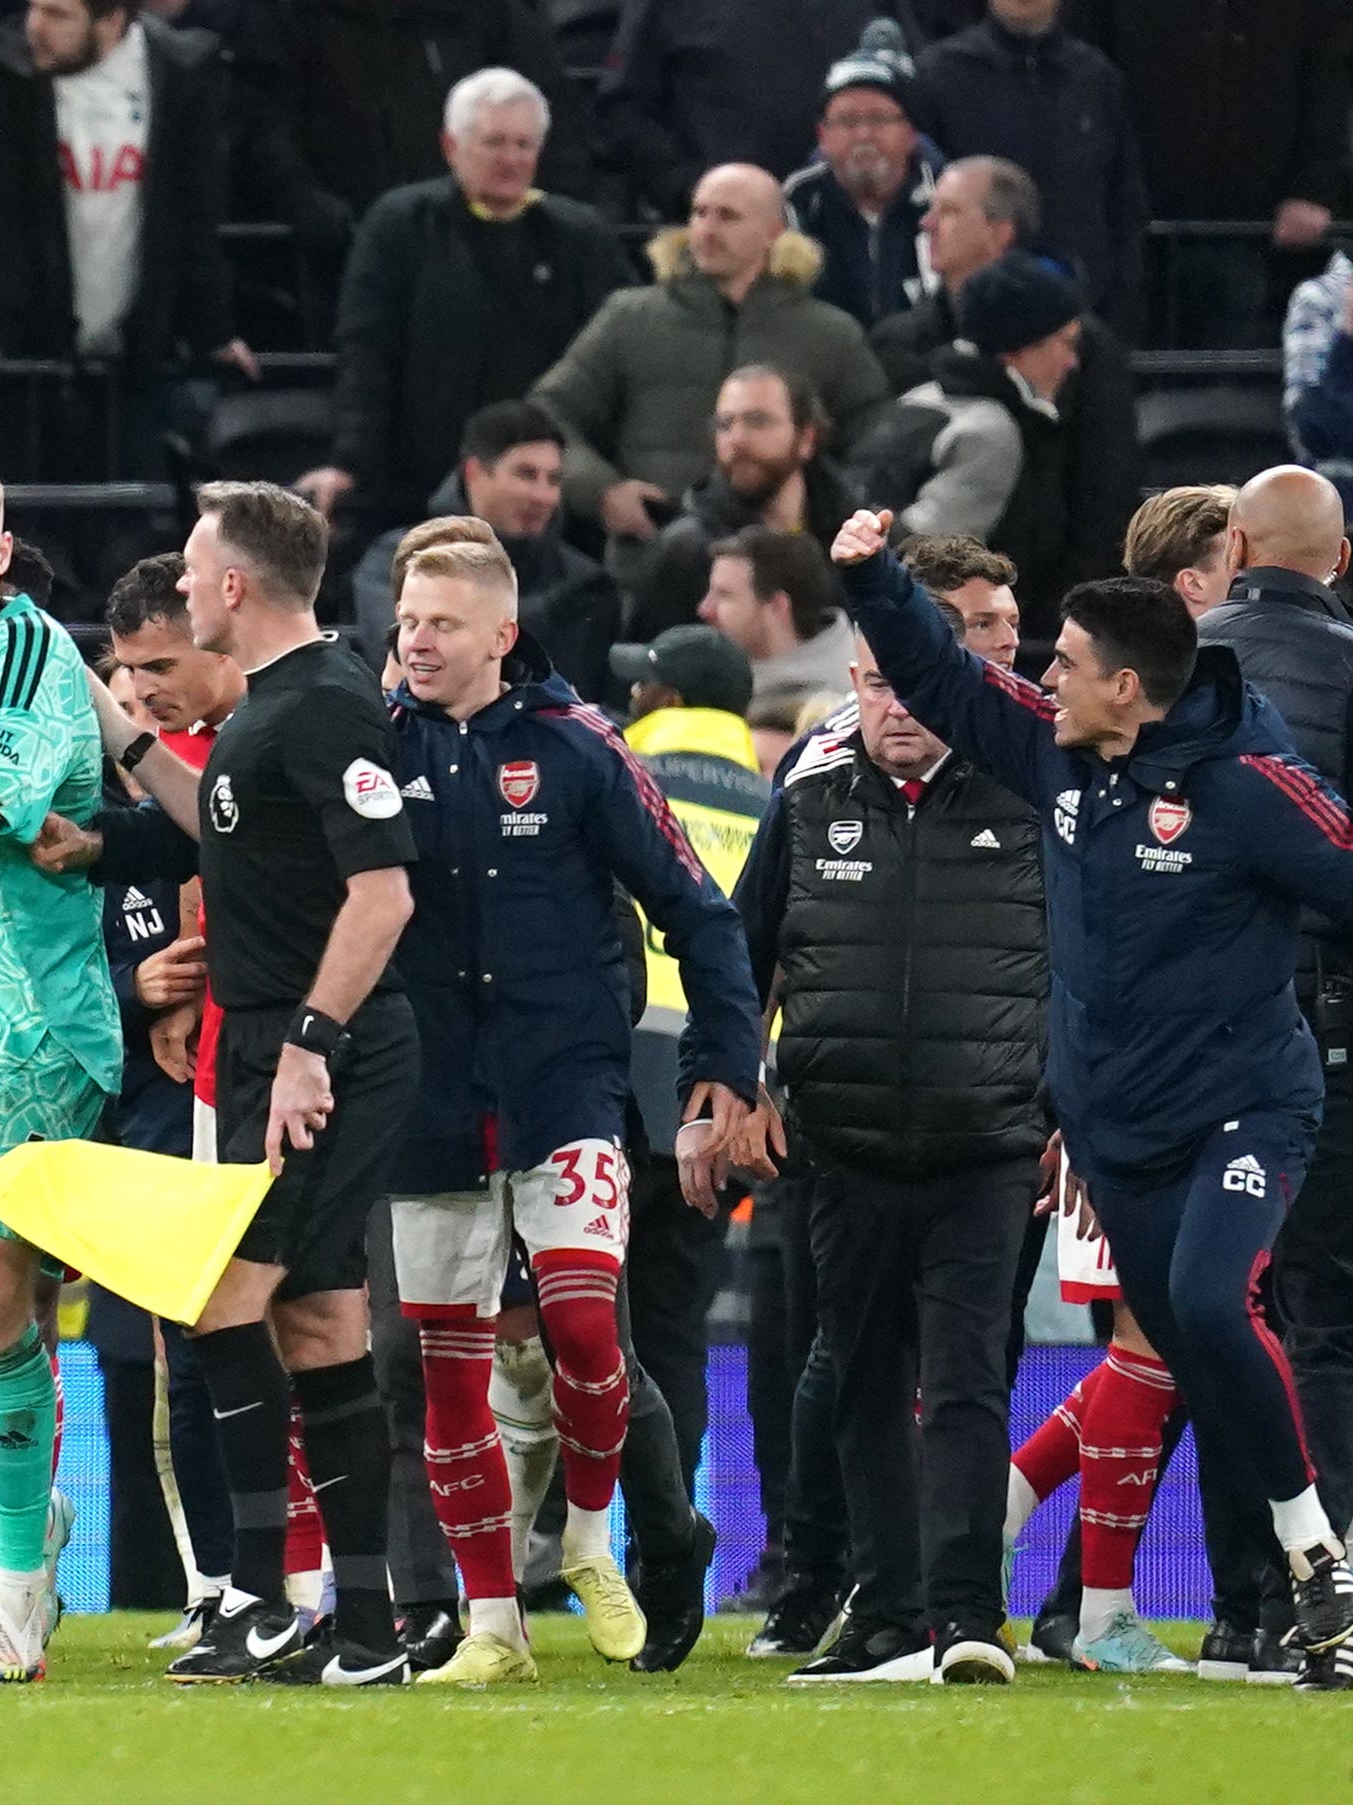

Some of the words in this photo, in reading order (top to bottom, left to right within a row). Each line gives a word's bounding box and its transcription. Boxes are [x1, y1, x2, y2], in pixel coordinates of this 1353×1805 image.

[355, 771, 391, 793] EA
[815, 858, 873, 872] Emirates
[1135, 844, 1193, 864] Emirates
[125, 908, 165, 941] NJ
[551, 1148, 618, 1210] 35
[1223, 1169, 1266, 1198] CC
[430, 1474, 485, 1496] AFC
